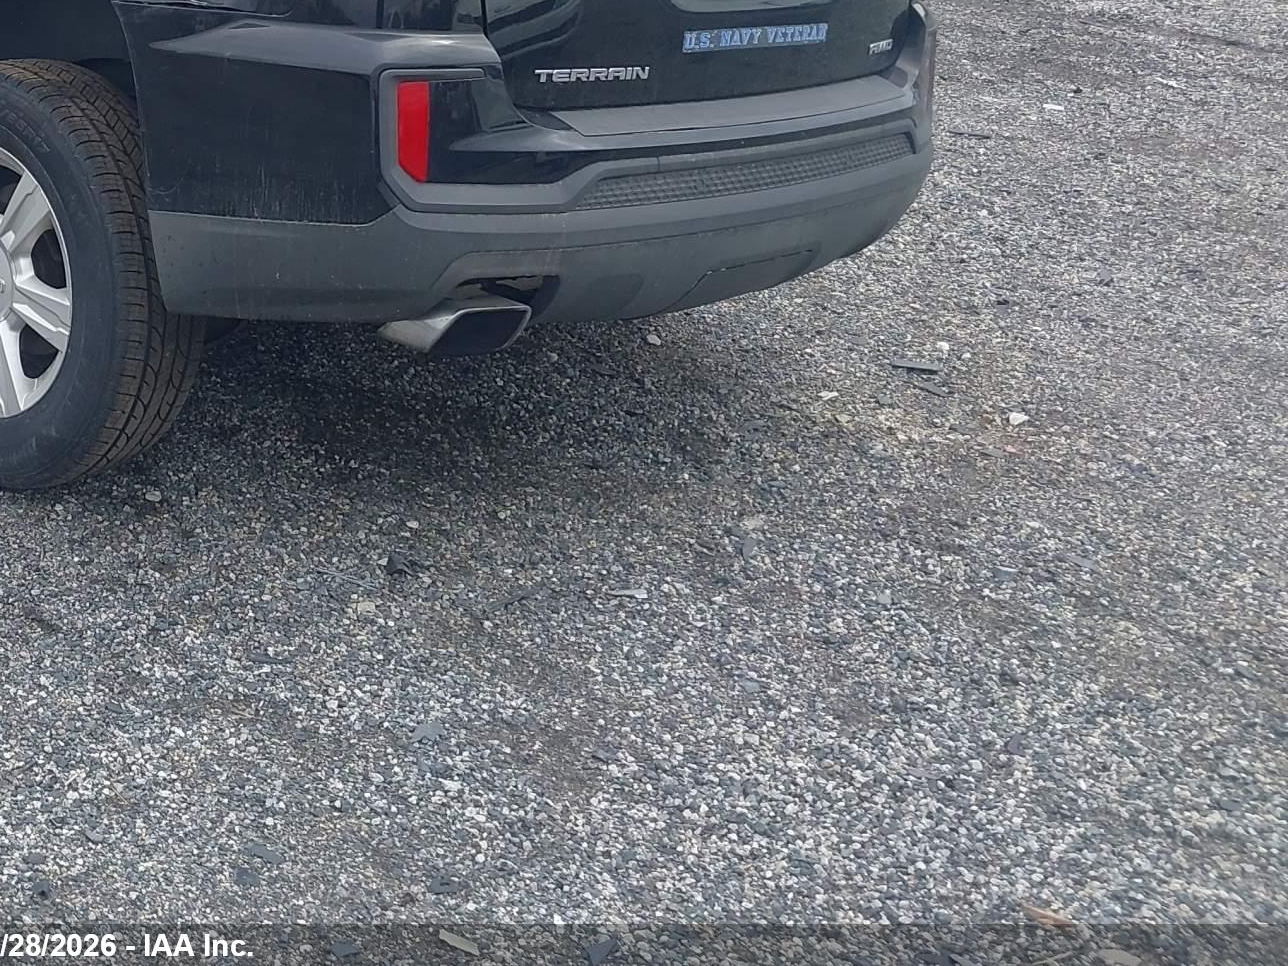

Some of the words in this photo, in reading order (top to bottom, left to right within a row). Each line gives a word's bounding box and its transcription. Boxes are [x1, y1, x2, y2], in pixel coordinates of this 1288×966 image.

[684, 34, 715, 50] U.S.
[719, 29, 762, 47] NAVY
[766, 24, 829, 43] VETERAN
[533, 65, 650, 83] TERRAIN
